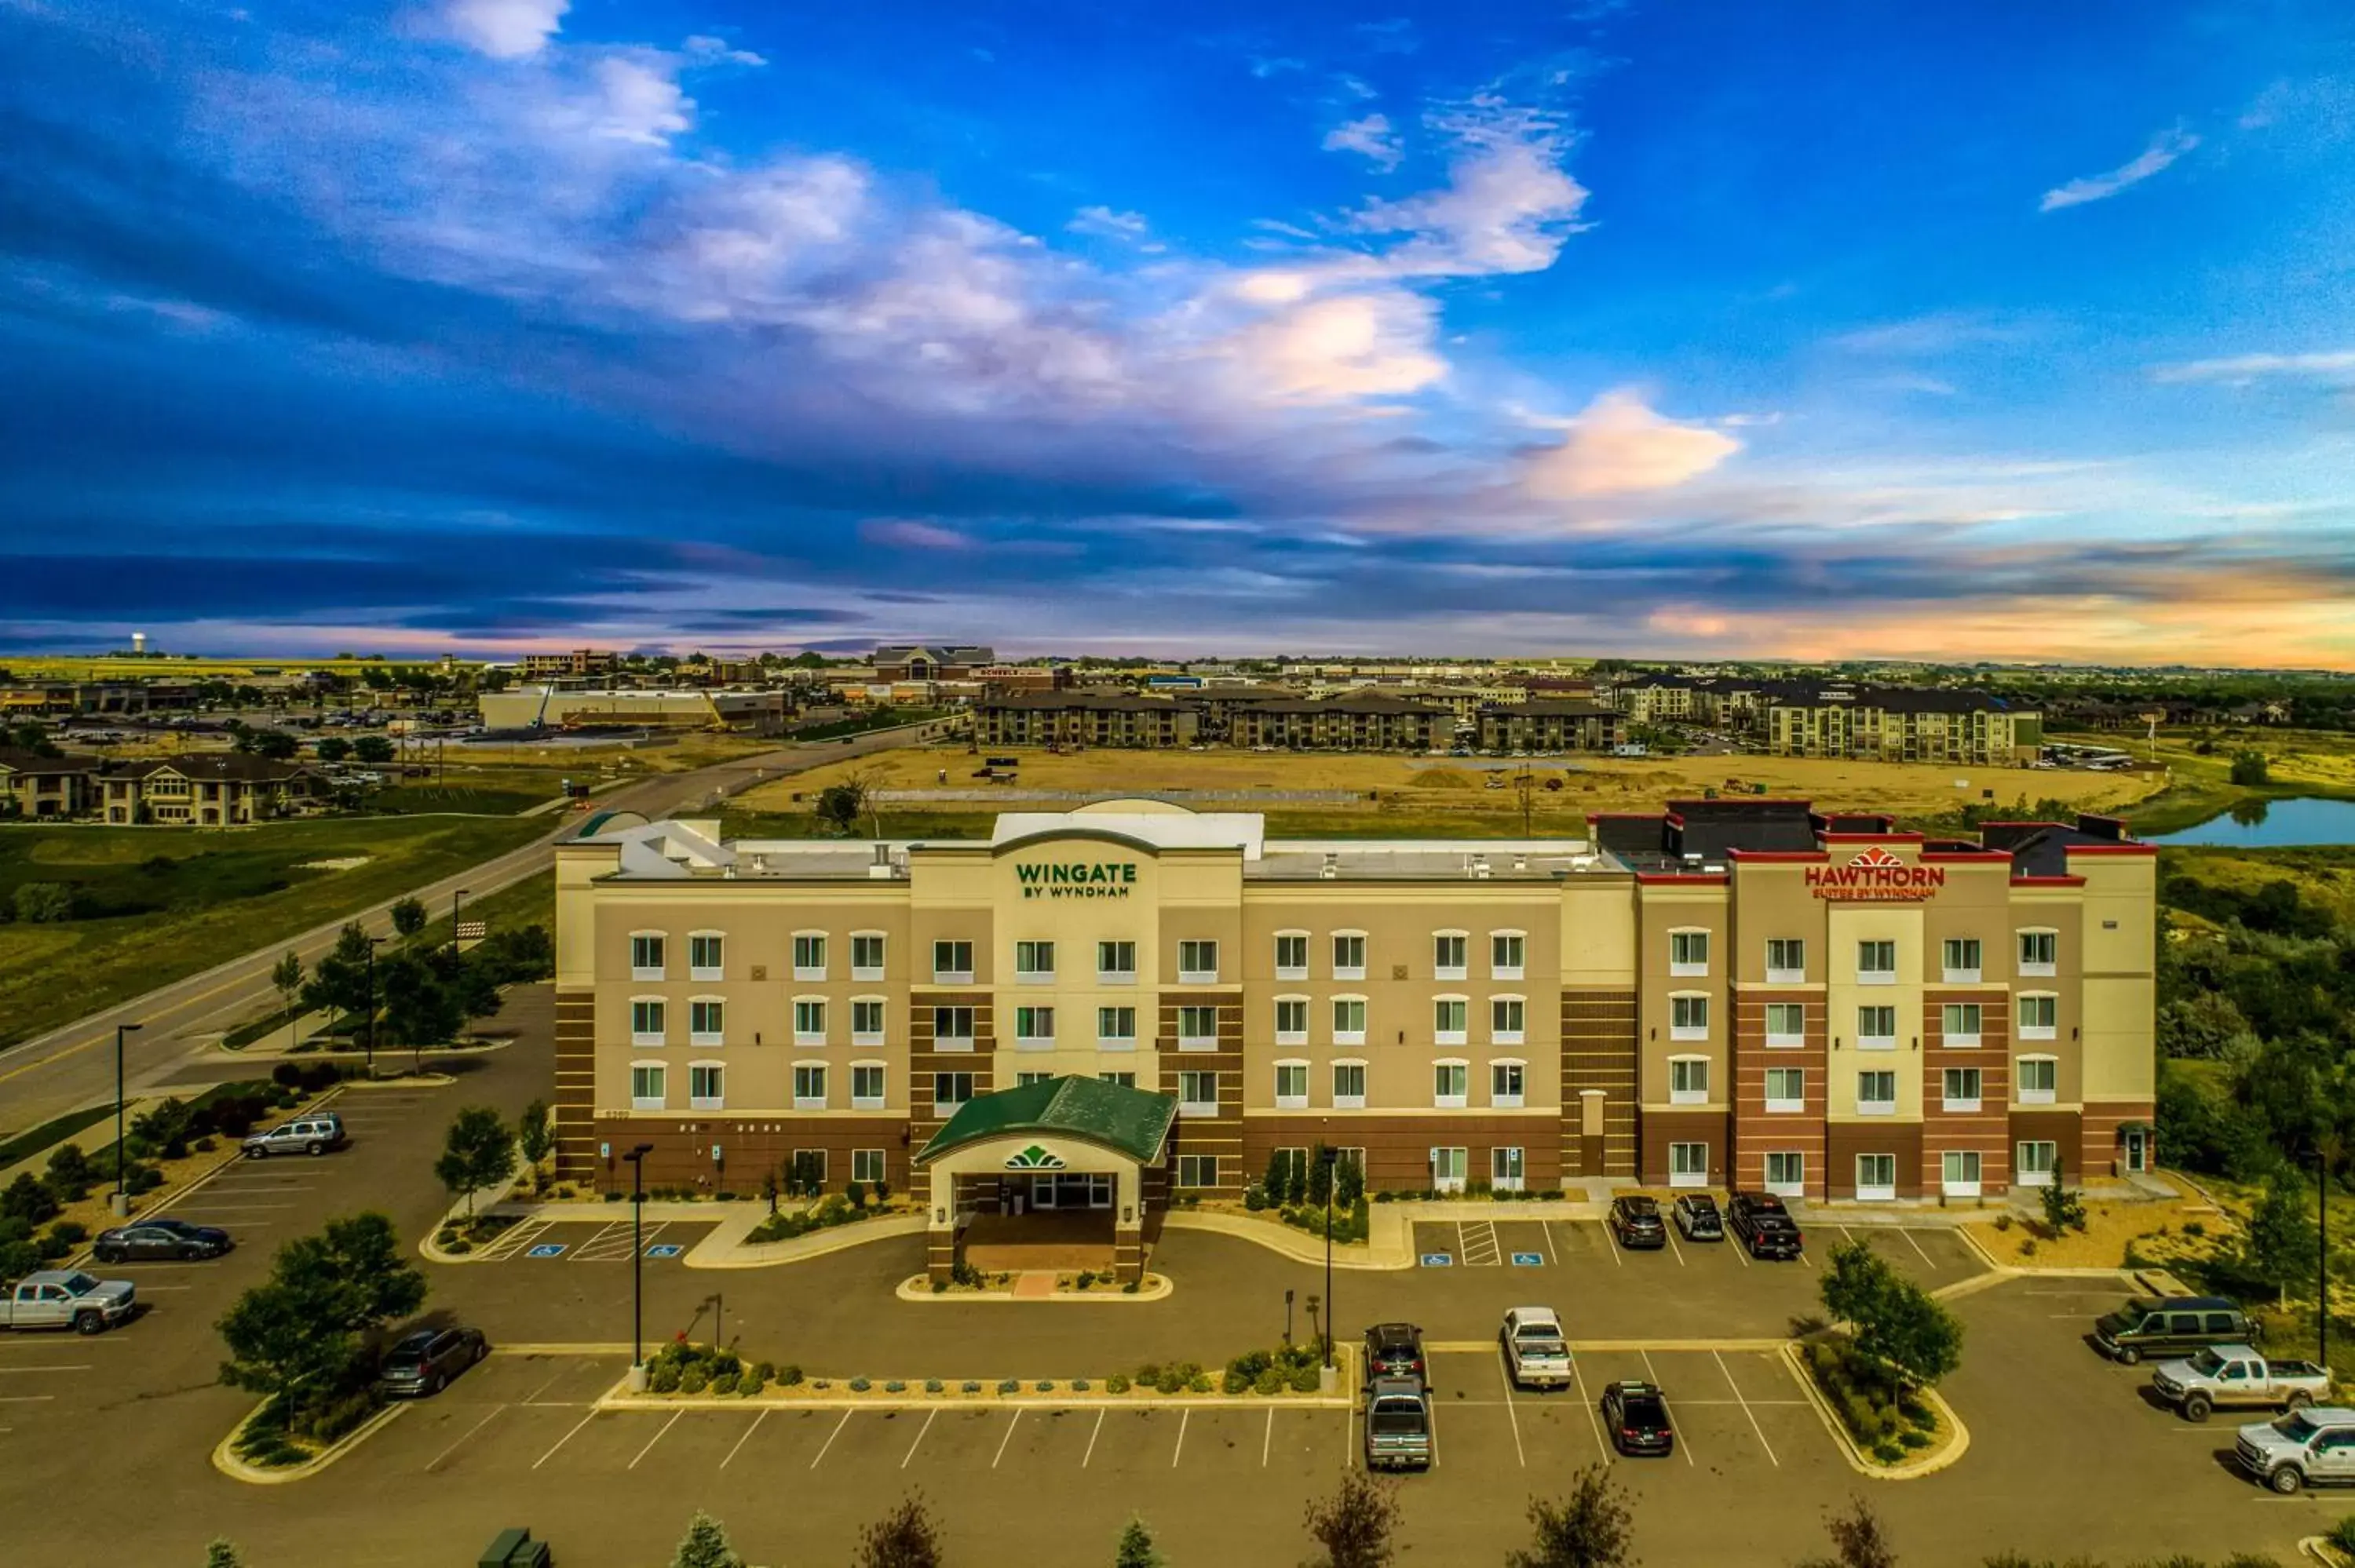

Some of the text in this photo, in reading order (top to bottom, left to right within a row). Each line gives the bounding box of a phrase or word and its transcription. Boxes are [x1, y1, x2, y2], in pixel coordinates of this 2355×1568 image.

[1017, 864, 1137, 883] WINGATE
[1805, 866, 1944, 886] HAWTHORN
[1024, 887, 1128, 898] BY WYNDHAM
[1813, 888, 1935, 899] SUITES BY WYNDHAM
